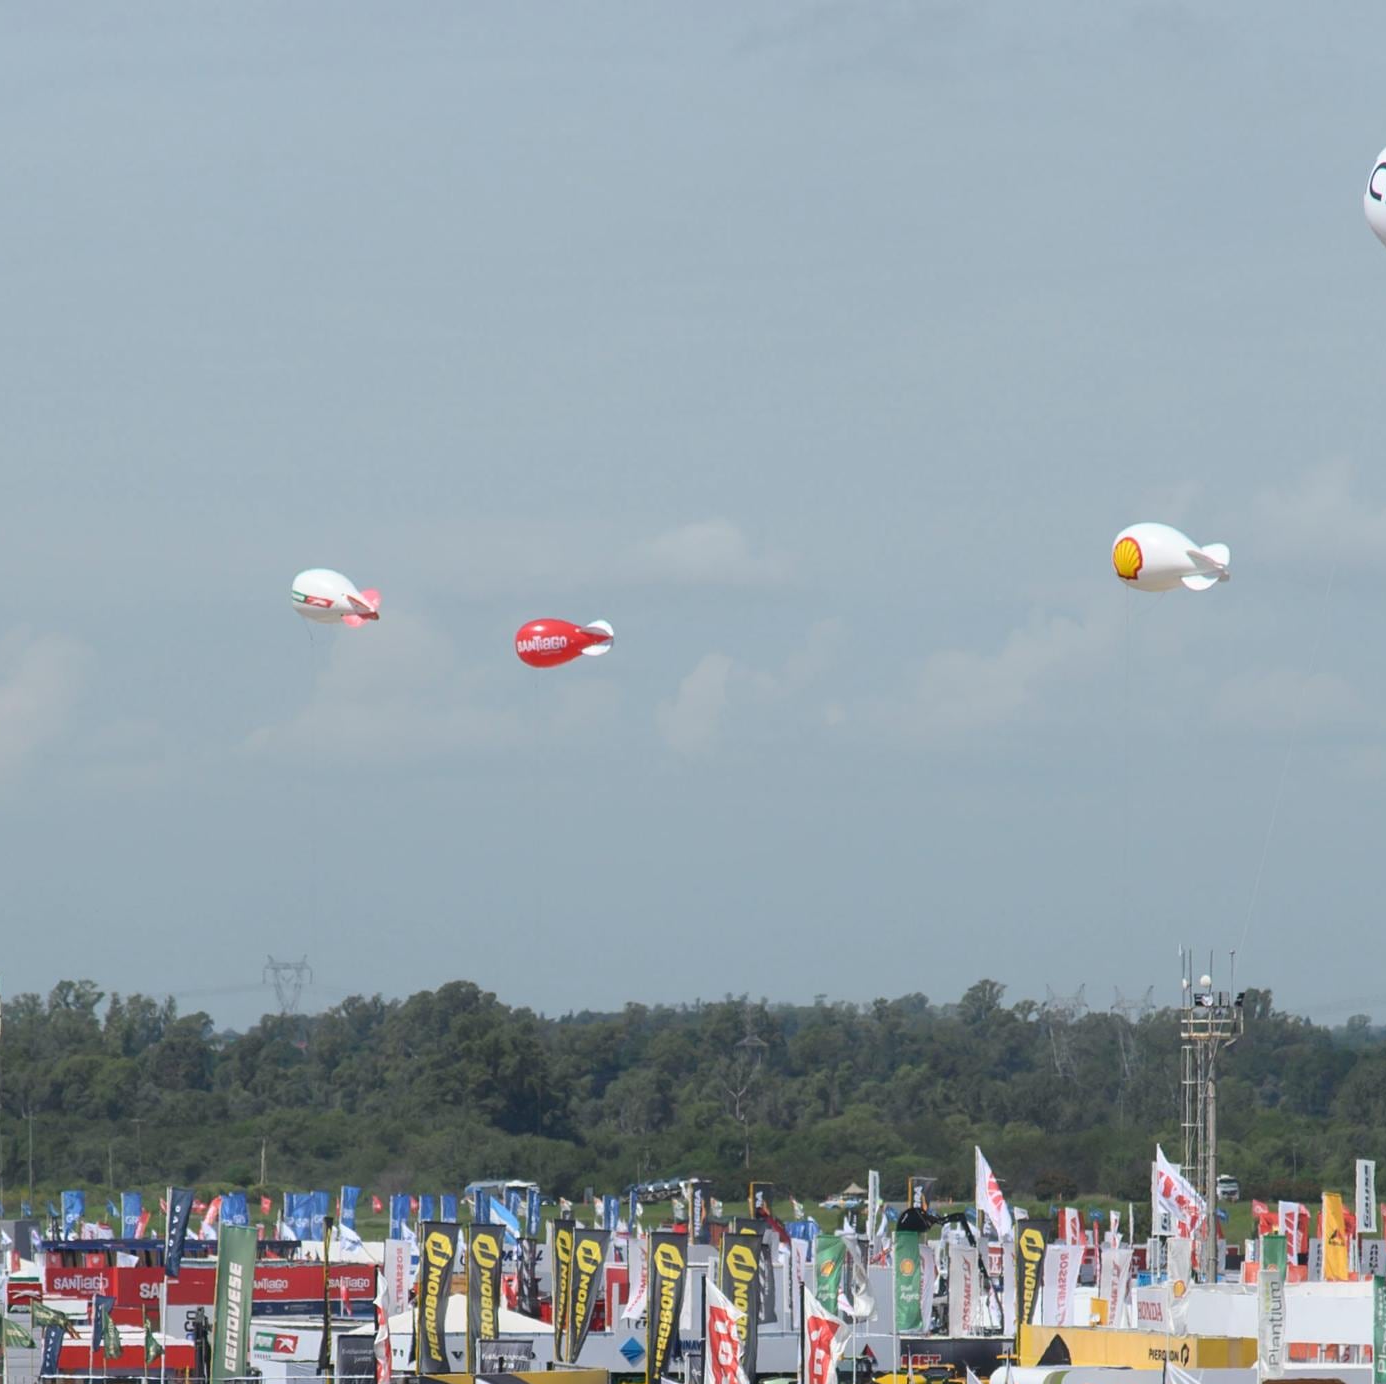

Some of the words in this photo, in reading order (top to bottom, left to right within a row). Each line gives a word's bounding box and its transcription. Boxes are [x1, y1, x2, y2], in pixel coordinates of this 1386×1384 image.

[224, 1260, 243, 1373] GENOVESE
[424, 1266, 443, 1362] PIEROBON
[481, 1269, 495, 1341] EROBON
[1148, 1348, 1180, 1362] PIEROON
